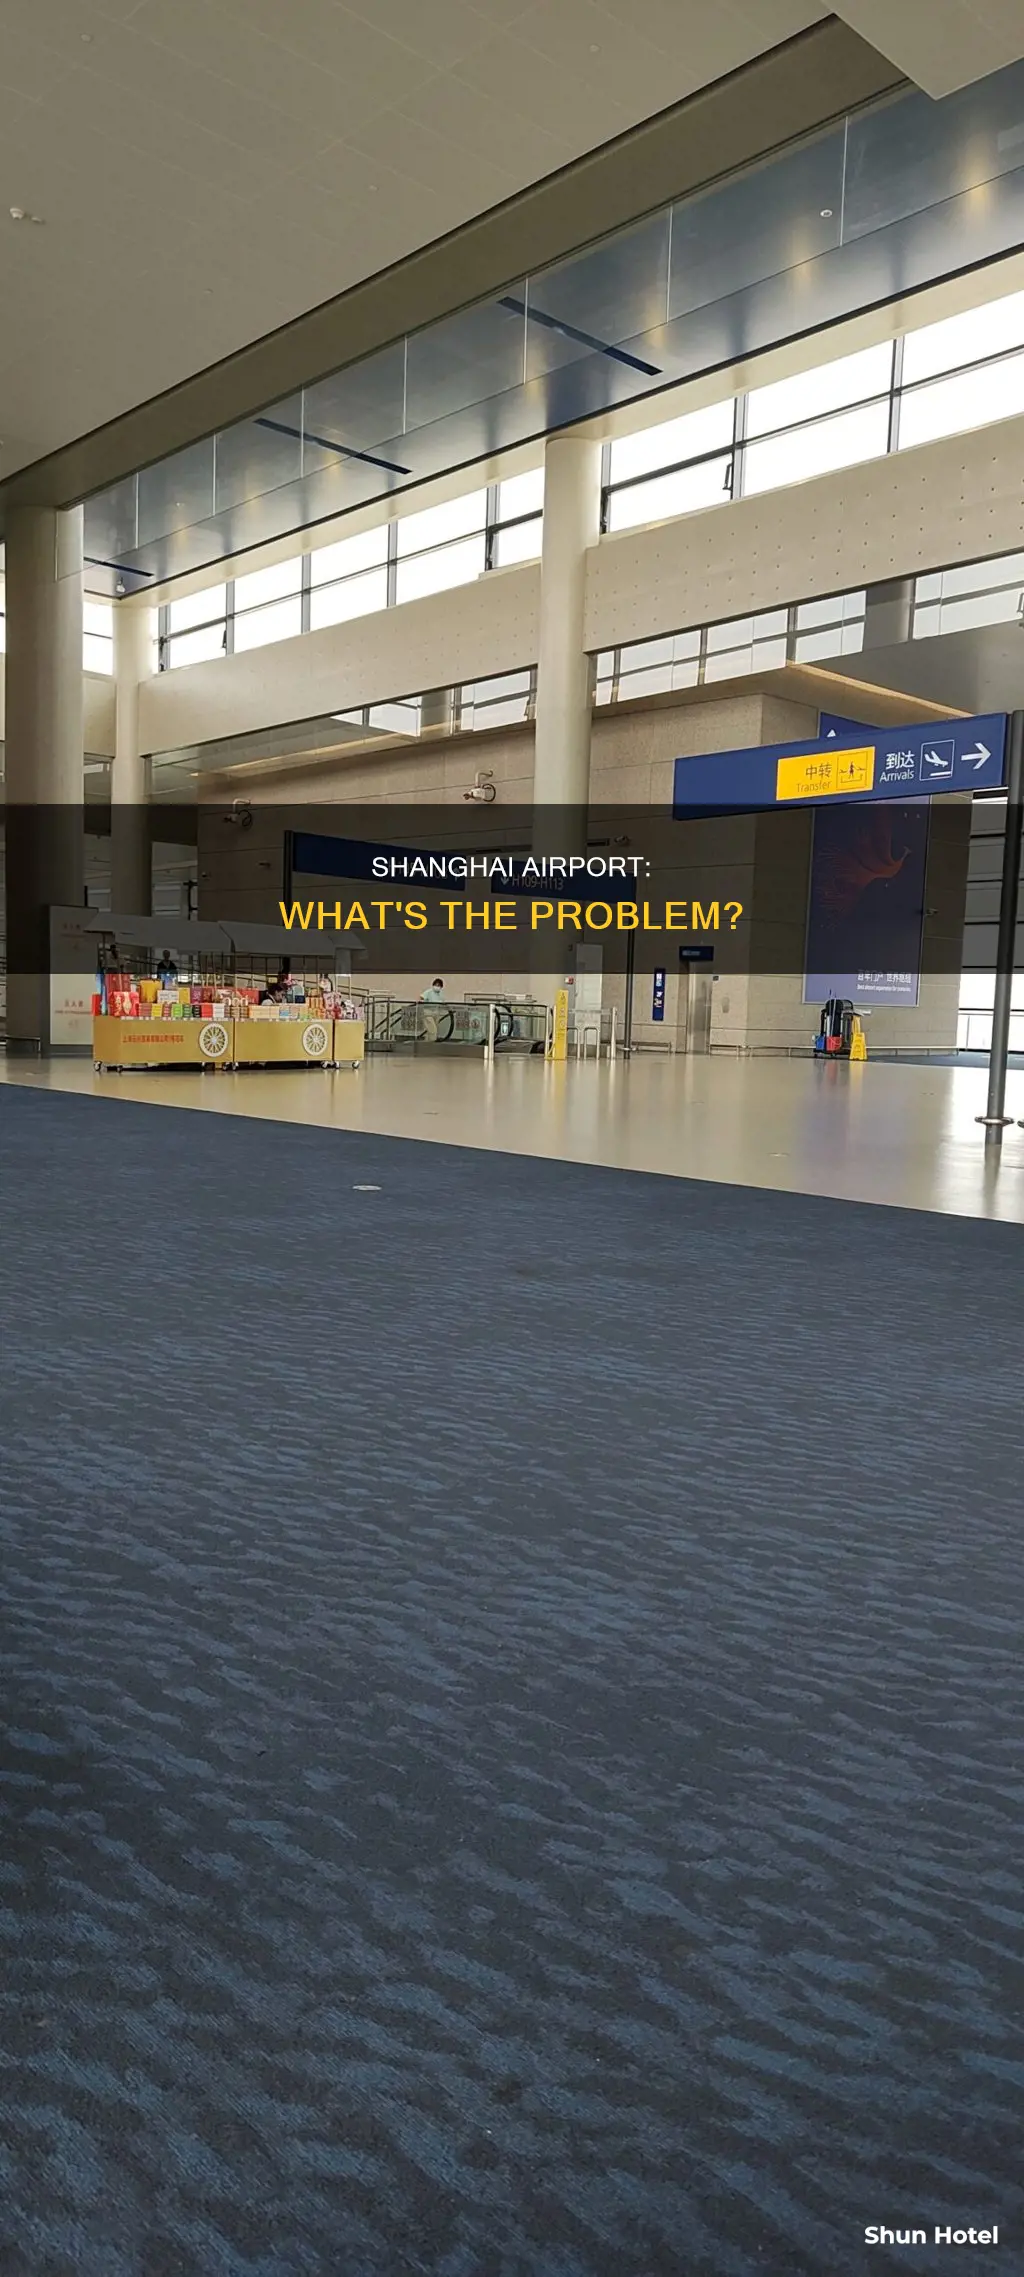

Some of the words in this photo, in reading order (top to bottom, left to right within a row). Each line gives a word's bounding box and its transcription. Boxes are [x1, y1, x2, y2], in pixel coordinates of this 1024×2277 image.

[886, 750, 915, 770] 到达
[805, 762, 833, 780] 中转
[879, 769, 915, 783] Arrivals
[796, 781, 832, 793] Transfer
